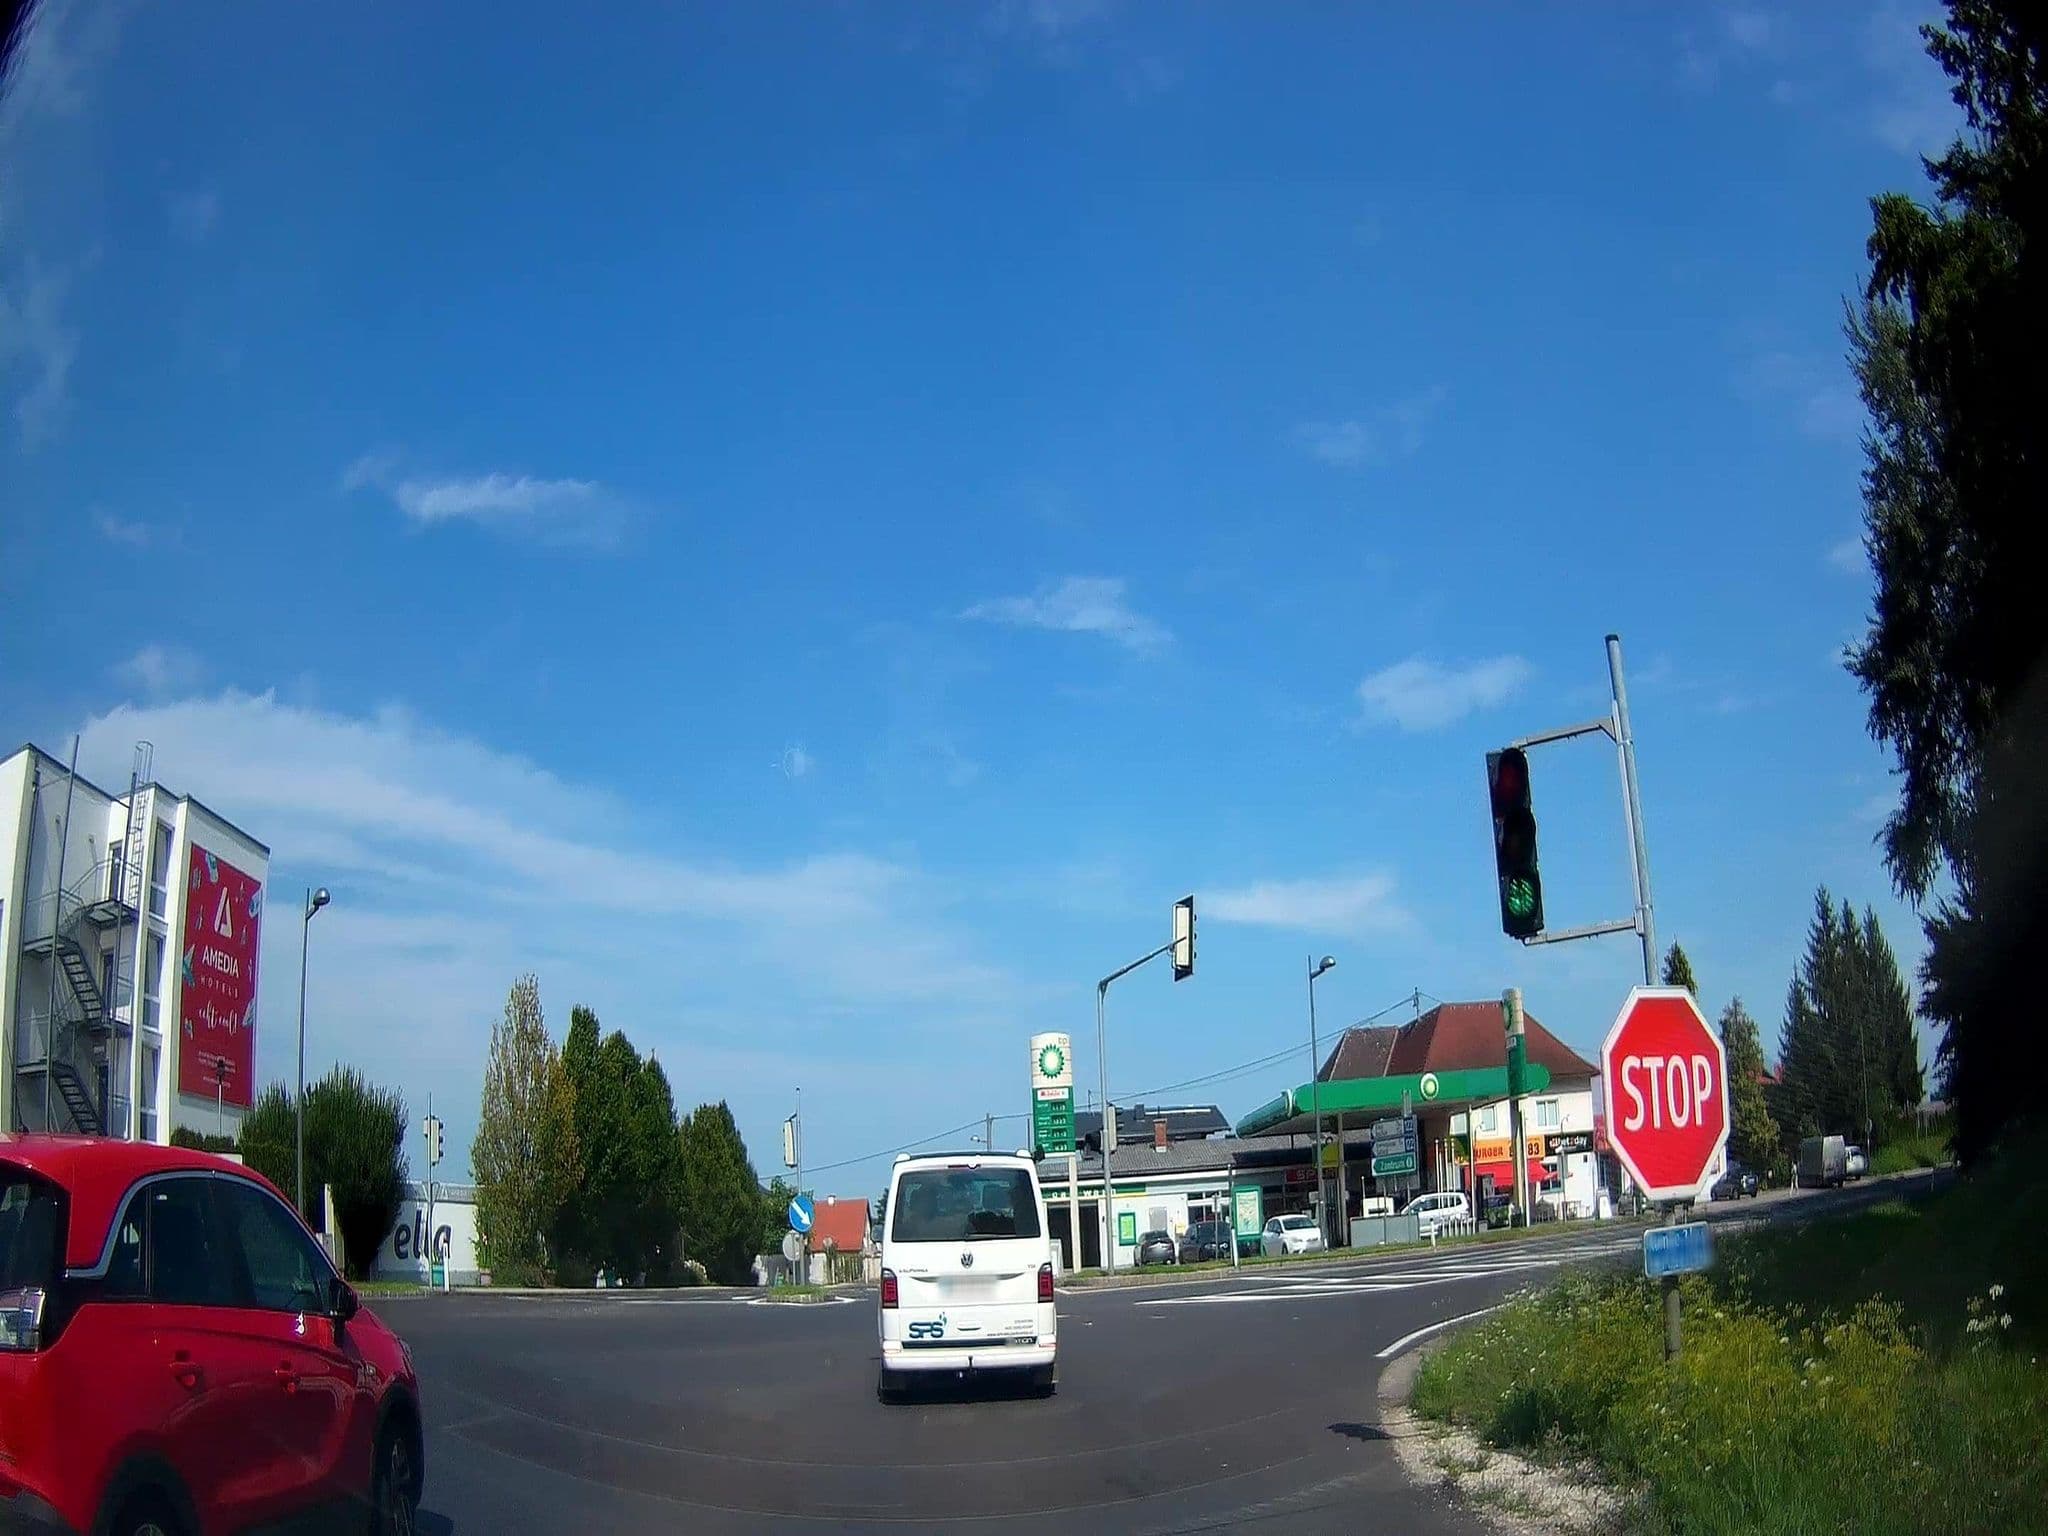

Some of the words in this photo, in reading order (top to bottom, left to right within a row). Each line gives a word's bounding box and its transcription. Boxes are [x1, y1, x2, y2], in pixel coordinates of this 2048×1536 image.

[201, 945, 240, 979] AMEDIA
[200, 976, 239, 998] HOTELS
[1620, 1054, 1712, 1131] STOP
